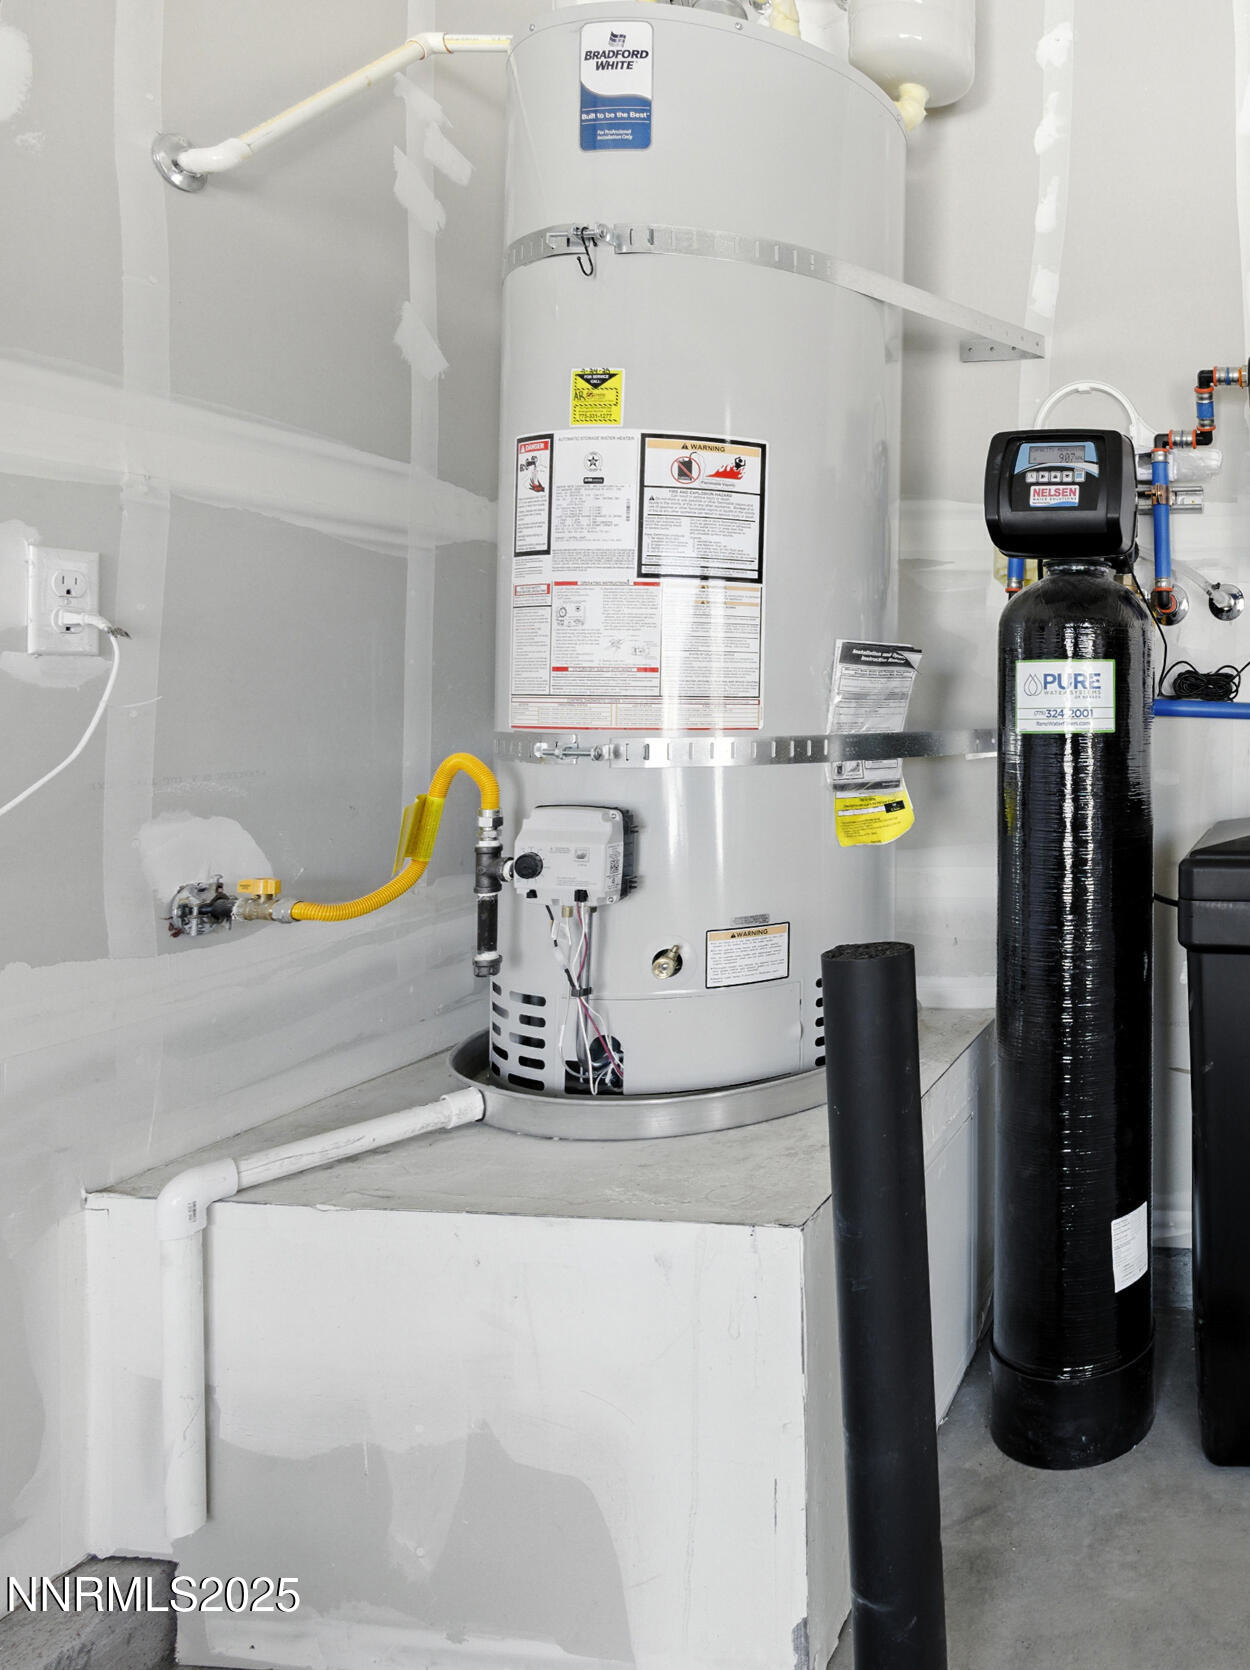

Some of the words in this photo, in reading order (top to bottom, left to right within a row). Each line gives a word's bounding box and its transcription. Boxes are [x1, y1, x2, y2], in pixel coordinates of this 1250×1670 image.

[584, 49, 649, 61] BRADFORD
[595, 60, 634, 71] WHITE
[581, 112, 596, 120] Built
[690, 443, 726, 453] WARNING
[1032, 487, 1077, 497] NELSEN
[1043, 673, 1102, 690] PURE
[1046, 709, 1094, 719] 3242001
[736, 928, 769, 939] WARNING
